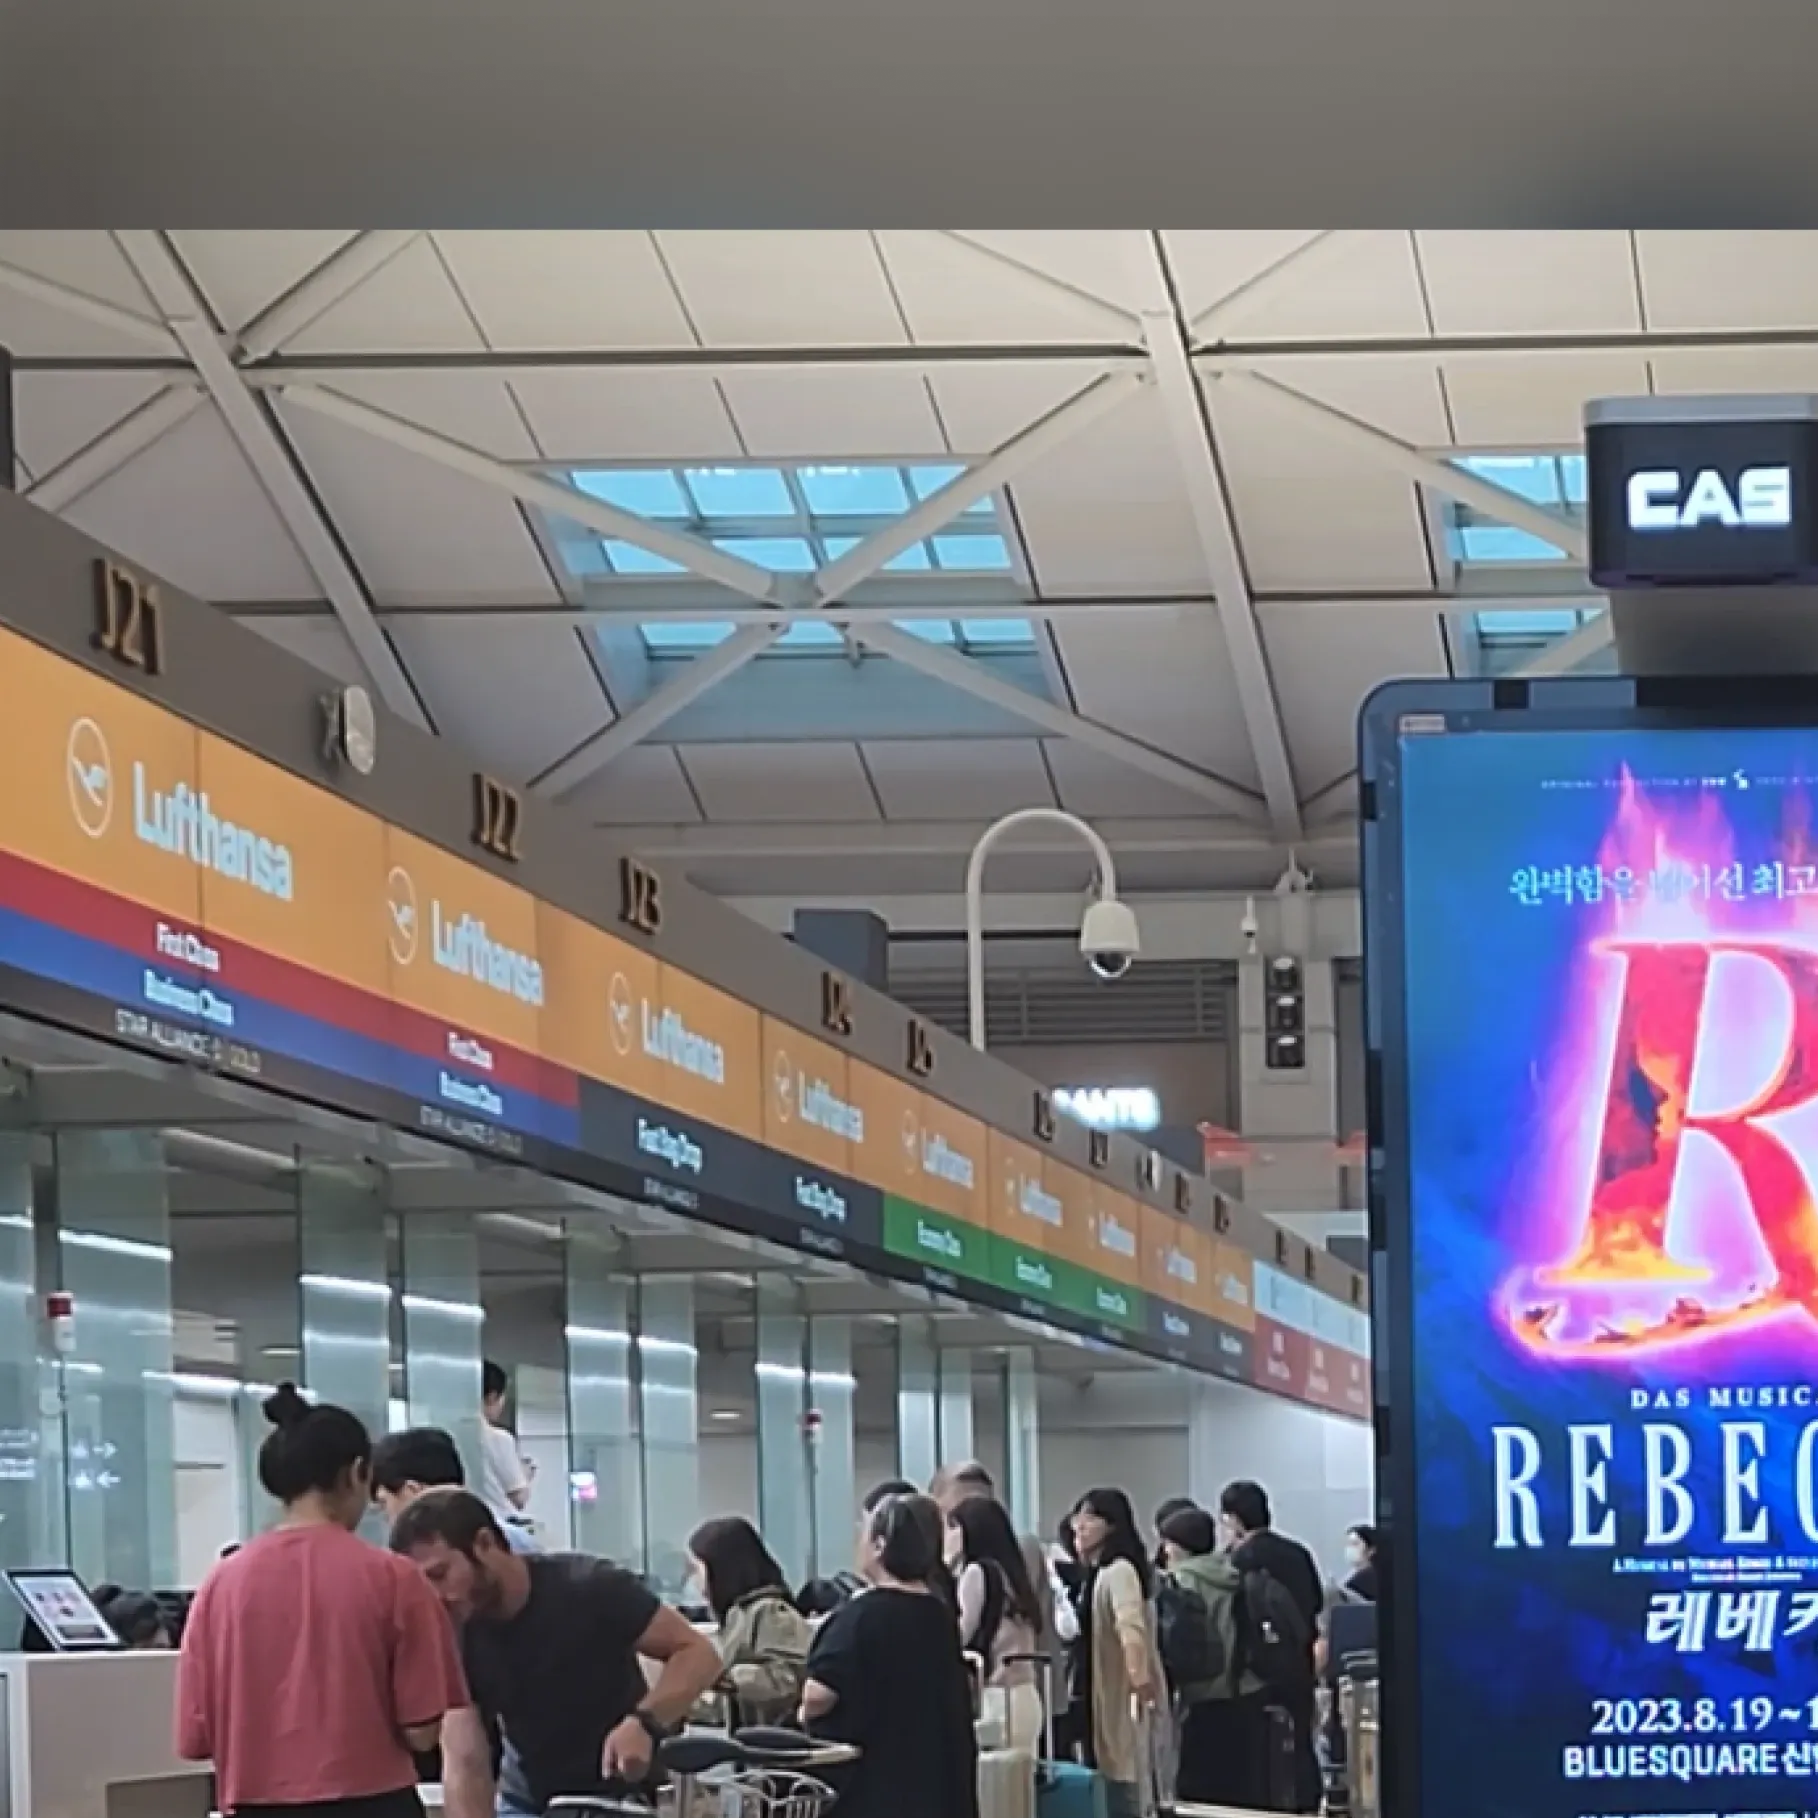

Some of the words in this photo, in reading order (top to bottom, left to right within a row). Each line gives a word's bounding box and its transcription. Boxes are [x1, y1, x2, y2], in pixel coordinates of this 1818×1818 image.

[1626, 465, 1792, 531] CAS
[92, 557, 167, 676] J21
[134, 760, 293, 901] Lufthansa
[432, 899, 543, 1006] Lufthansa
[641, 996, 724, 1084] Lufthansa
[1630, 1387, 1691, 1410] DAS
